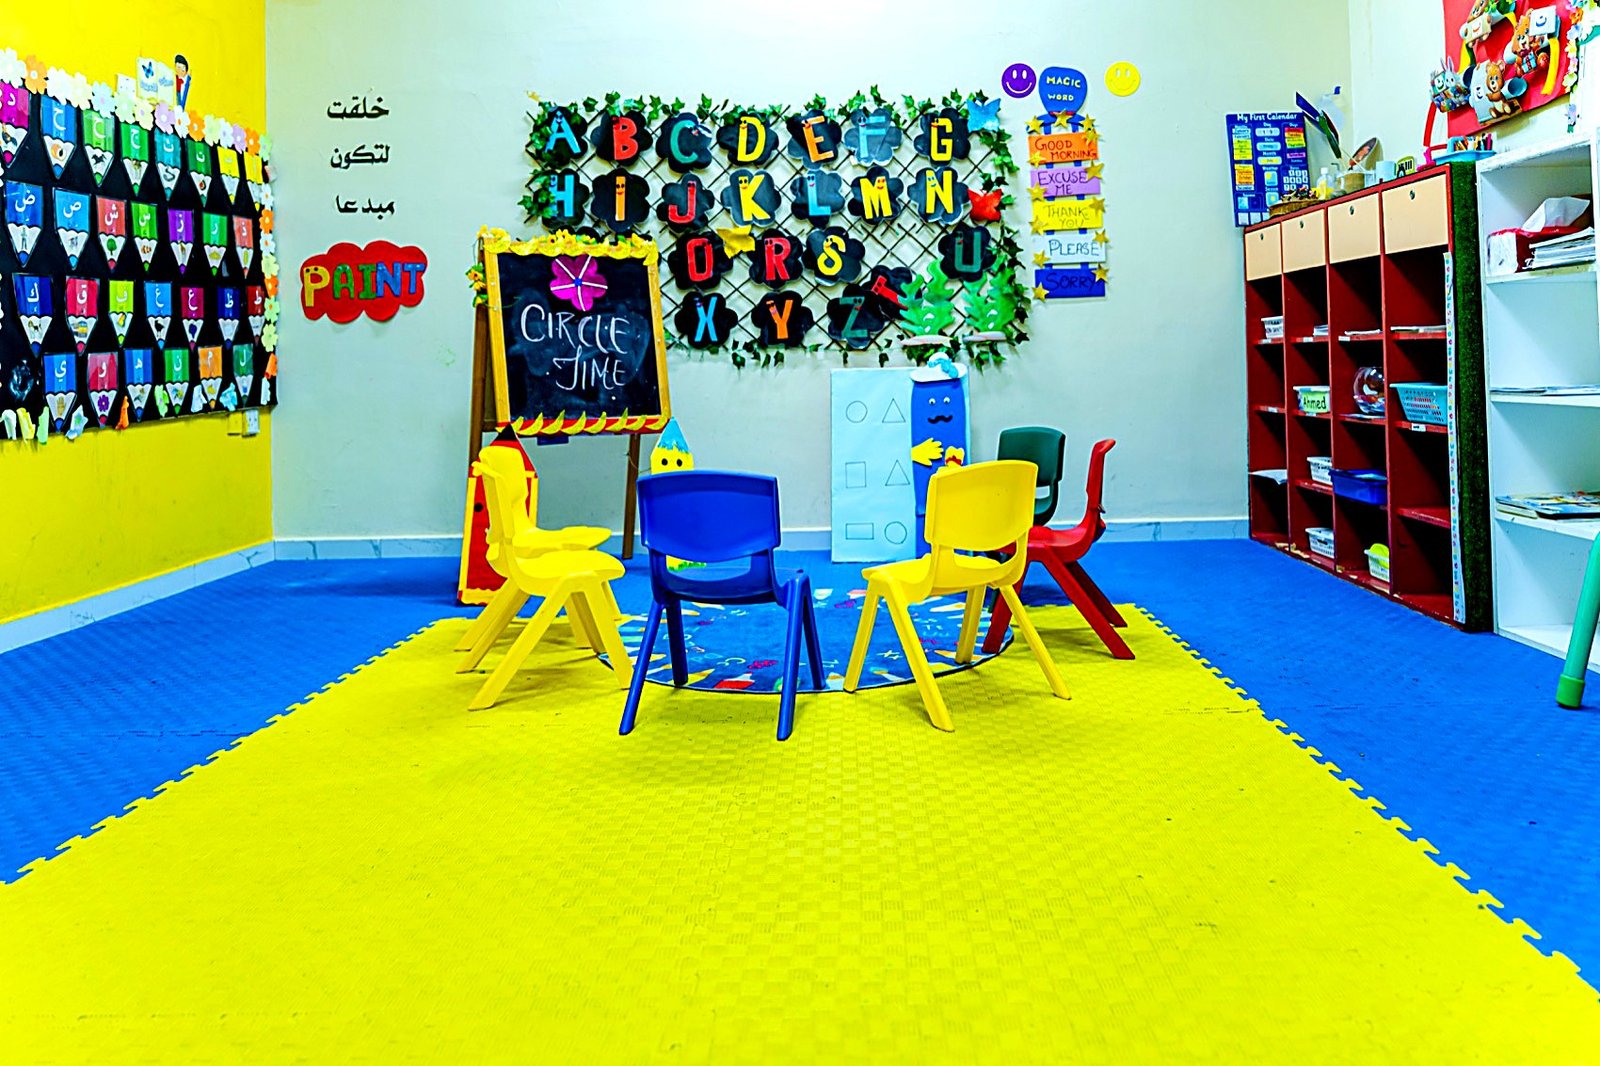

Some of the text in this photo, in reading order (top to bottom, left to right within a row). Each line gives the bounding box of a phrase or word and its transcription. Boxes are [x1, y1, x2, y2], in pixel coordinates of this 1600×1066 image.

[1046, 75, 1081, 88] MAGIC
[1047, 93, 1074, 102] WORD
[326, 96, 390, 120] خلقت
[1237, 112, 1298, 123] My First Calendar
[545, 110, 953, 163] A B C D E F G
[1035, 137, 1072, 151] GOOD
[330, 143, 391, 170] لتكون
[1050, 148, 1097, 160] MORNING
[1037, 169, 1089, 186] EXCUSE
[549, 169, 954, 224] H I J K L M N
[1055, 184, 1073, 196] ME
[14, 189, 36, 213] ض
[62, 200, 82, 218] ص
[335, 195, 395, 220] مبدعا
[1043, 205, 1089, 220] THANK
[1059, 217, 1085, 228] YOU
[764, 237, 791, 280] R
[817, 234, 847, 276] S
[954, 231, 982, 273] U
[1048, 239, 1100, 257] PLEASE
[302, 262, 427, 307] PAINT
[1046, 270, 1098, 290] SORRY
[520, 303, 630, 354] CIRCLE
[694, 296, 869, 342] X Y Z
[552, 344, 626, 391] TIME
[1303, 396, 1327, 410] Ahmed
